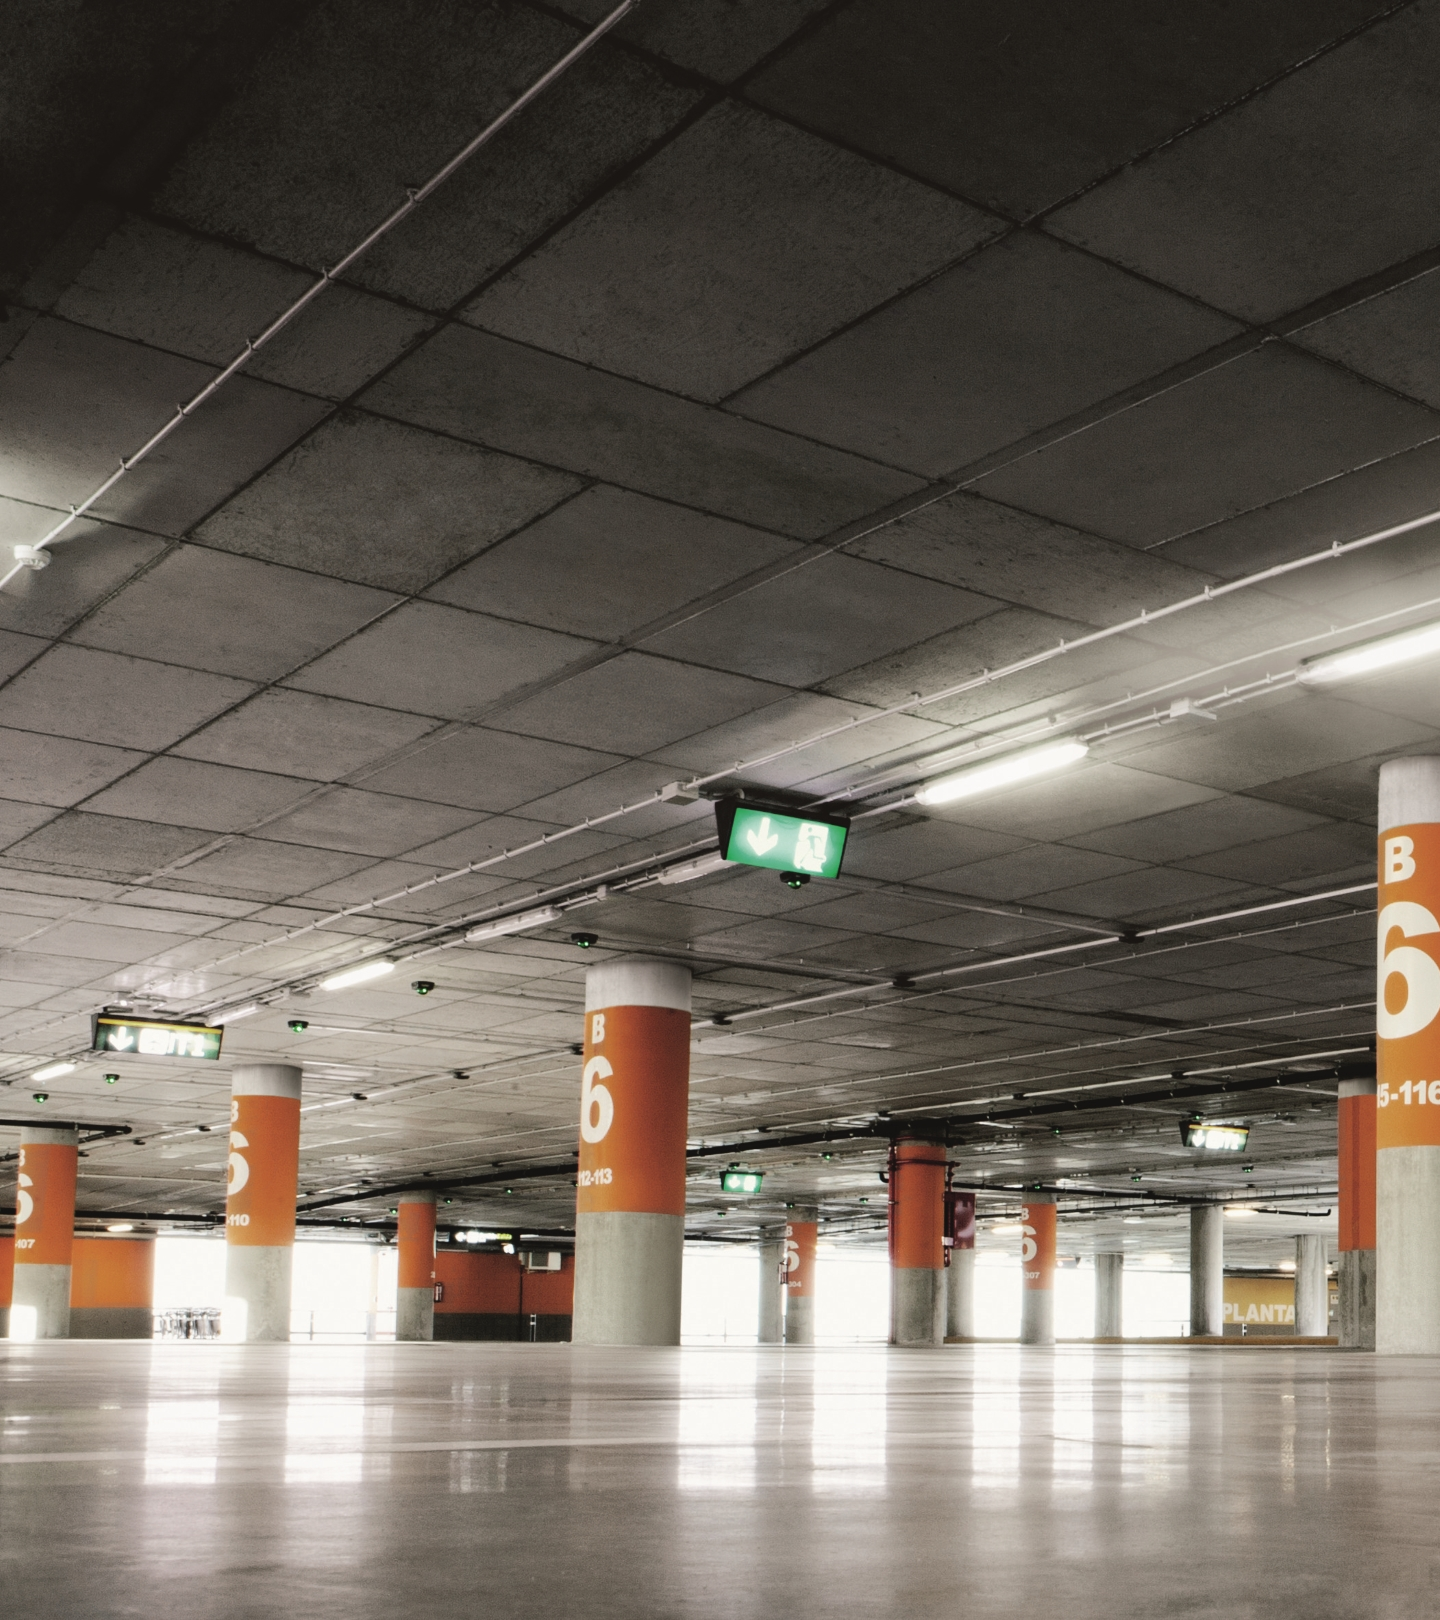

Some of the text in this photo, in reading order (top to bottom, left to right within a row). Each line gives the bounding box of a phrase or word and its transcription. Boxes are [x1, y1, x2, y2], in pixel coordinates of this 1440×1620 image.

[1385, 836, 1416, 885] B
[592, 1013, 605, 1044] B
[580, 1055, 614, 1144] 6
[1022, 1208, 1029, 1221] B
[1021, 1225, 1037, 1263] 6
[1222, 1303, 1295, 1322] PLANTA
